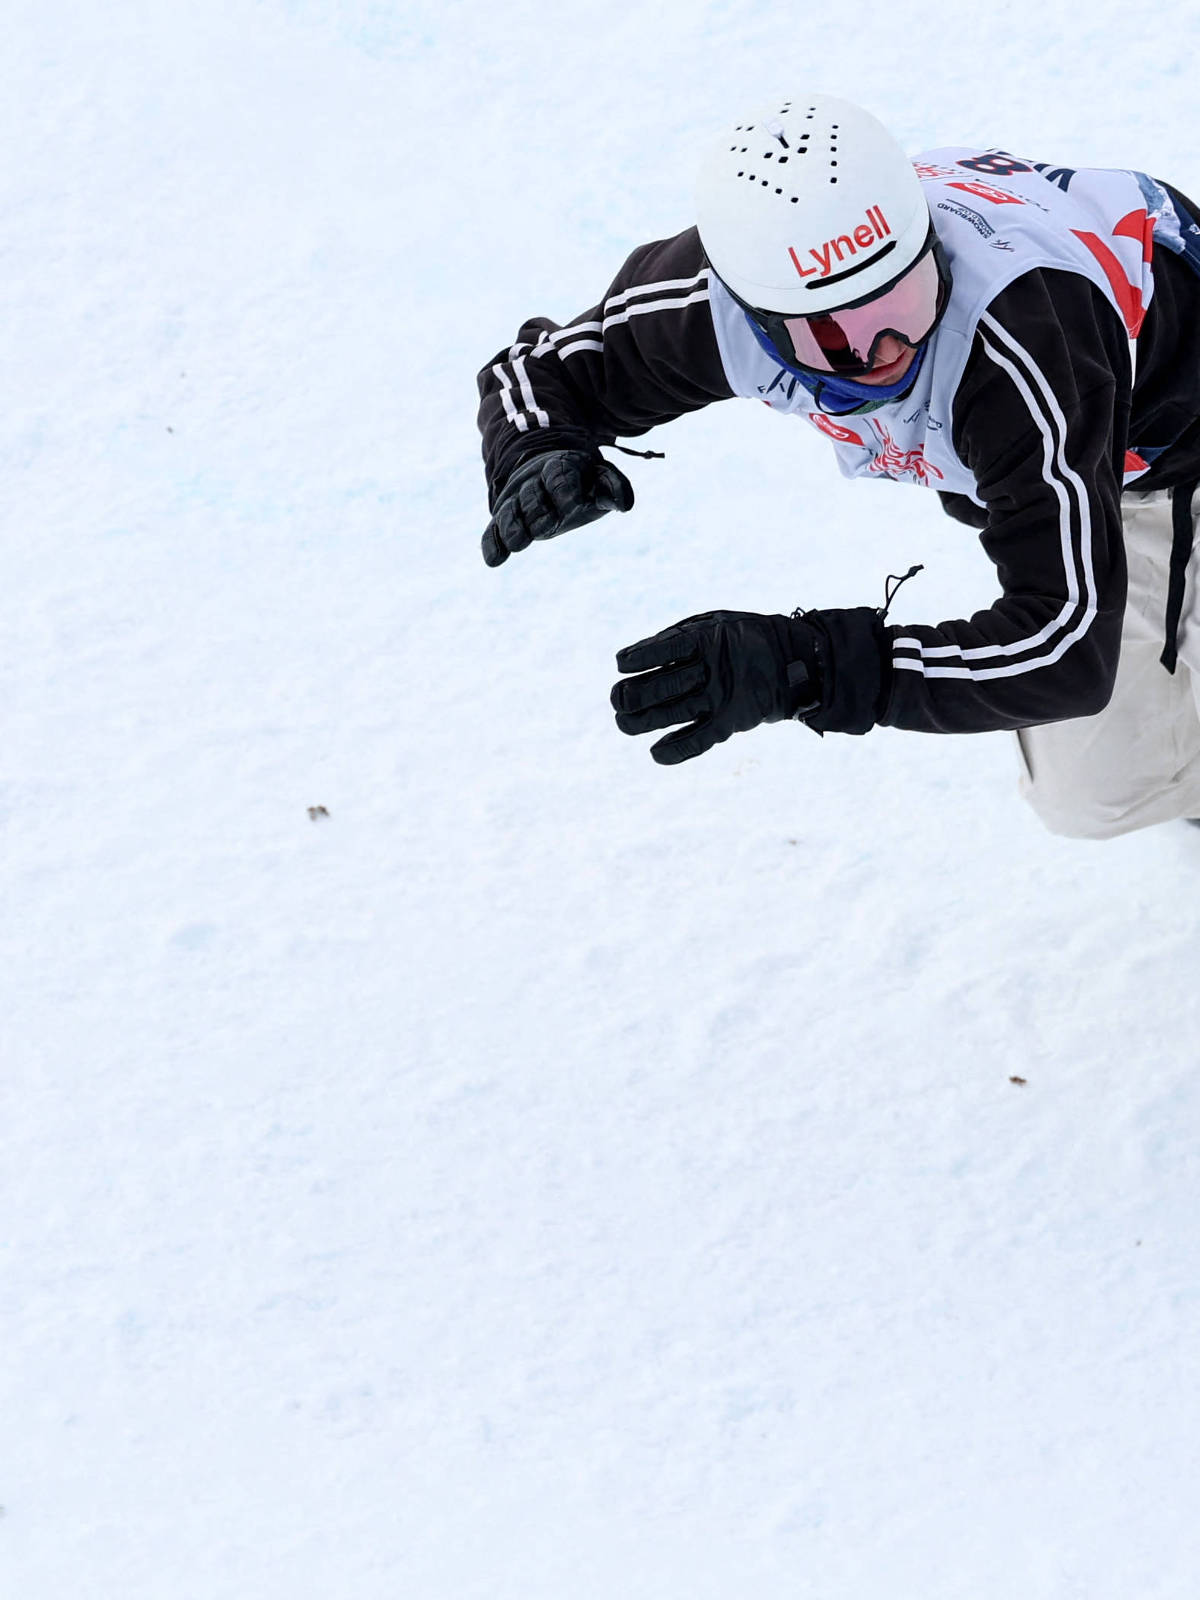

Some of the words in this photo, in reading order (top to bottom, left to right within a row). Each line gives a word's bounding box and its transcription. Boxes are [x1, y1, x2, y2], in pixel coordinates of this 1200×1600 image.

[937, 203, 989, 240] SNOWBOARD
[971, 214, 992, 238] WORLD
[787, 204, 892, 278] Lynell
